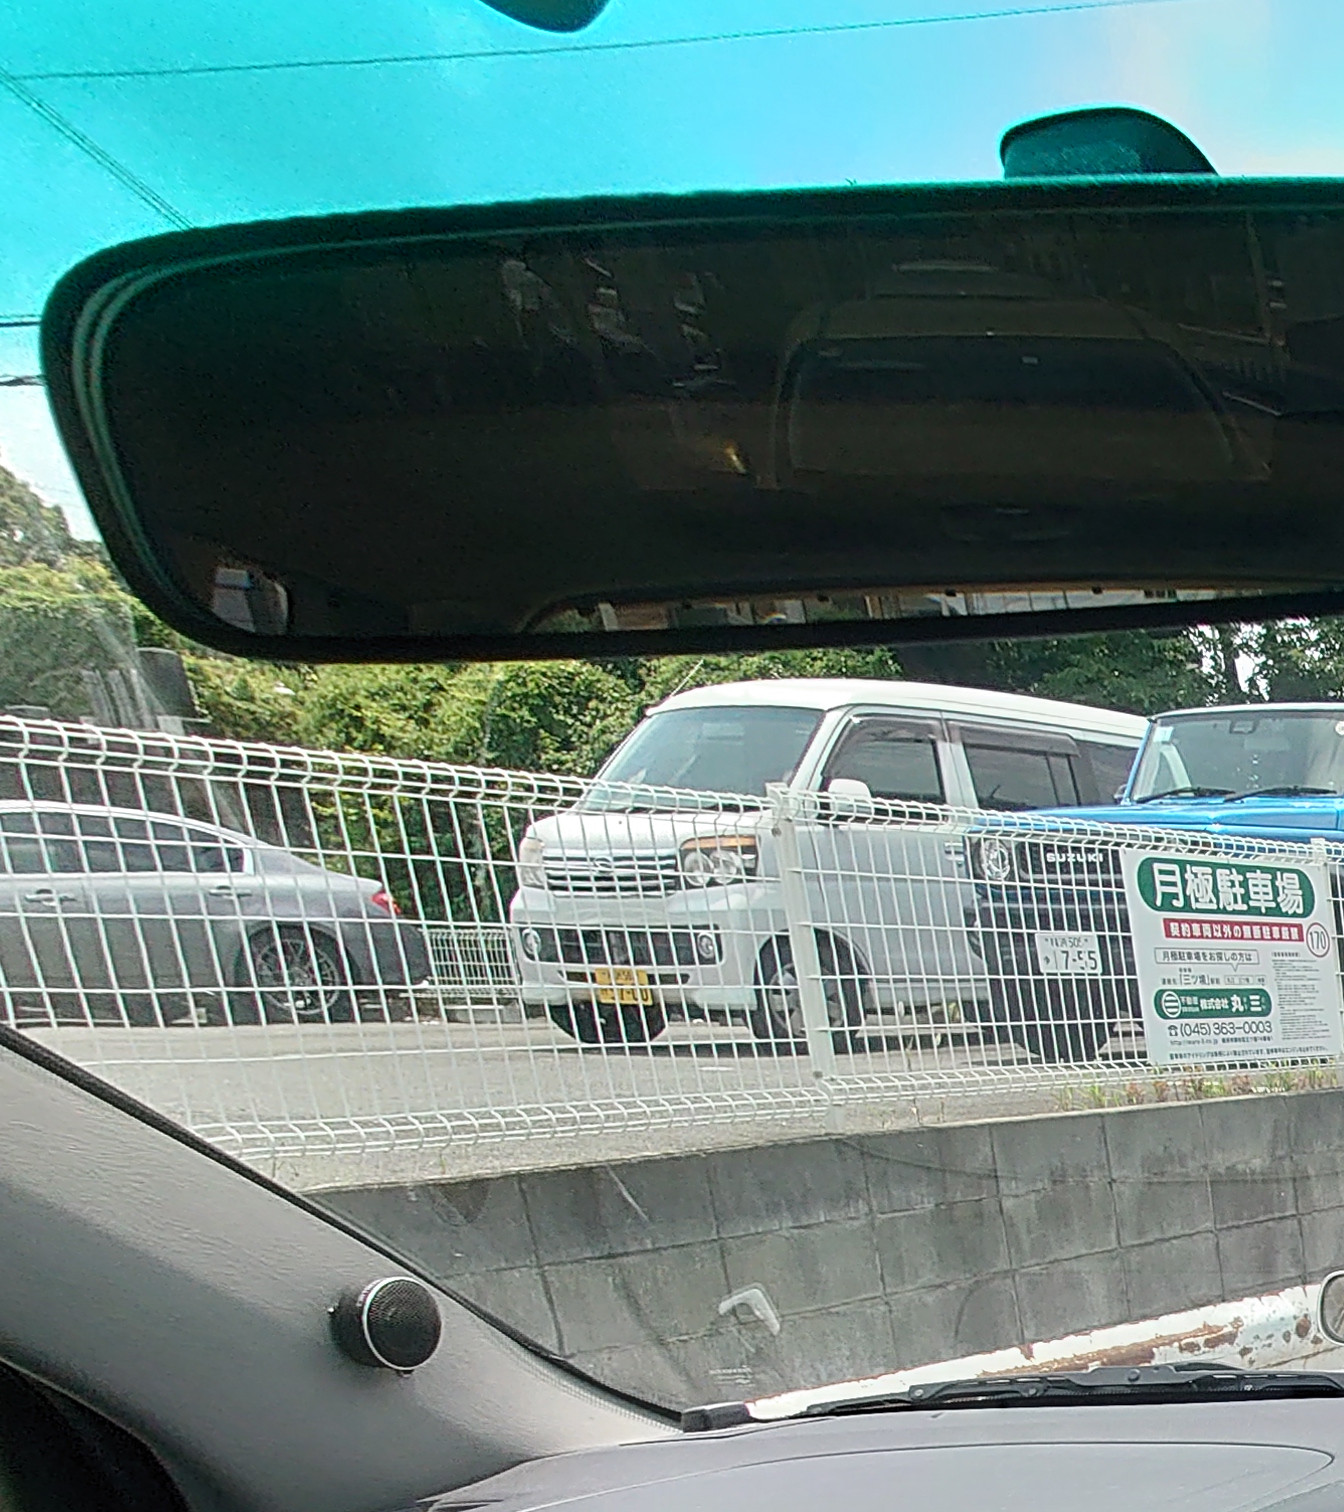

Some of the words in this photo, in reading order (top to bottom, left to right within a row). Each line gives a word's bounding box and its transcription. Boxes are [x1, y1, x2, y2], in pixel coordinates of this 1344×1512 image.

[1046, 852, 1104, 863] SUZUKI
[1152, 862, 1304, 915] 月極駐車場
[1308, 930, 1327, 950] 170
[1162, 950, 1252, 962] 月極駐車場をお探しの方は
